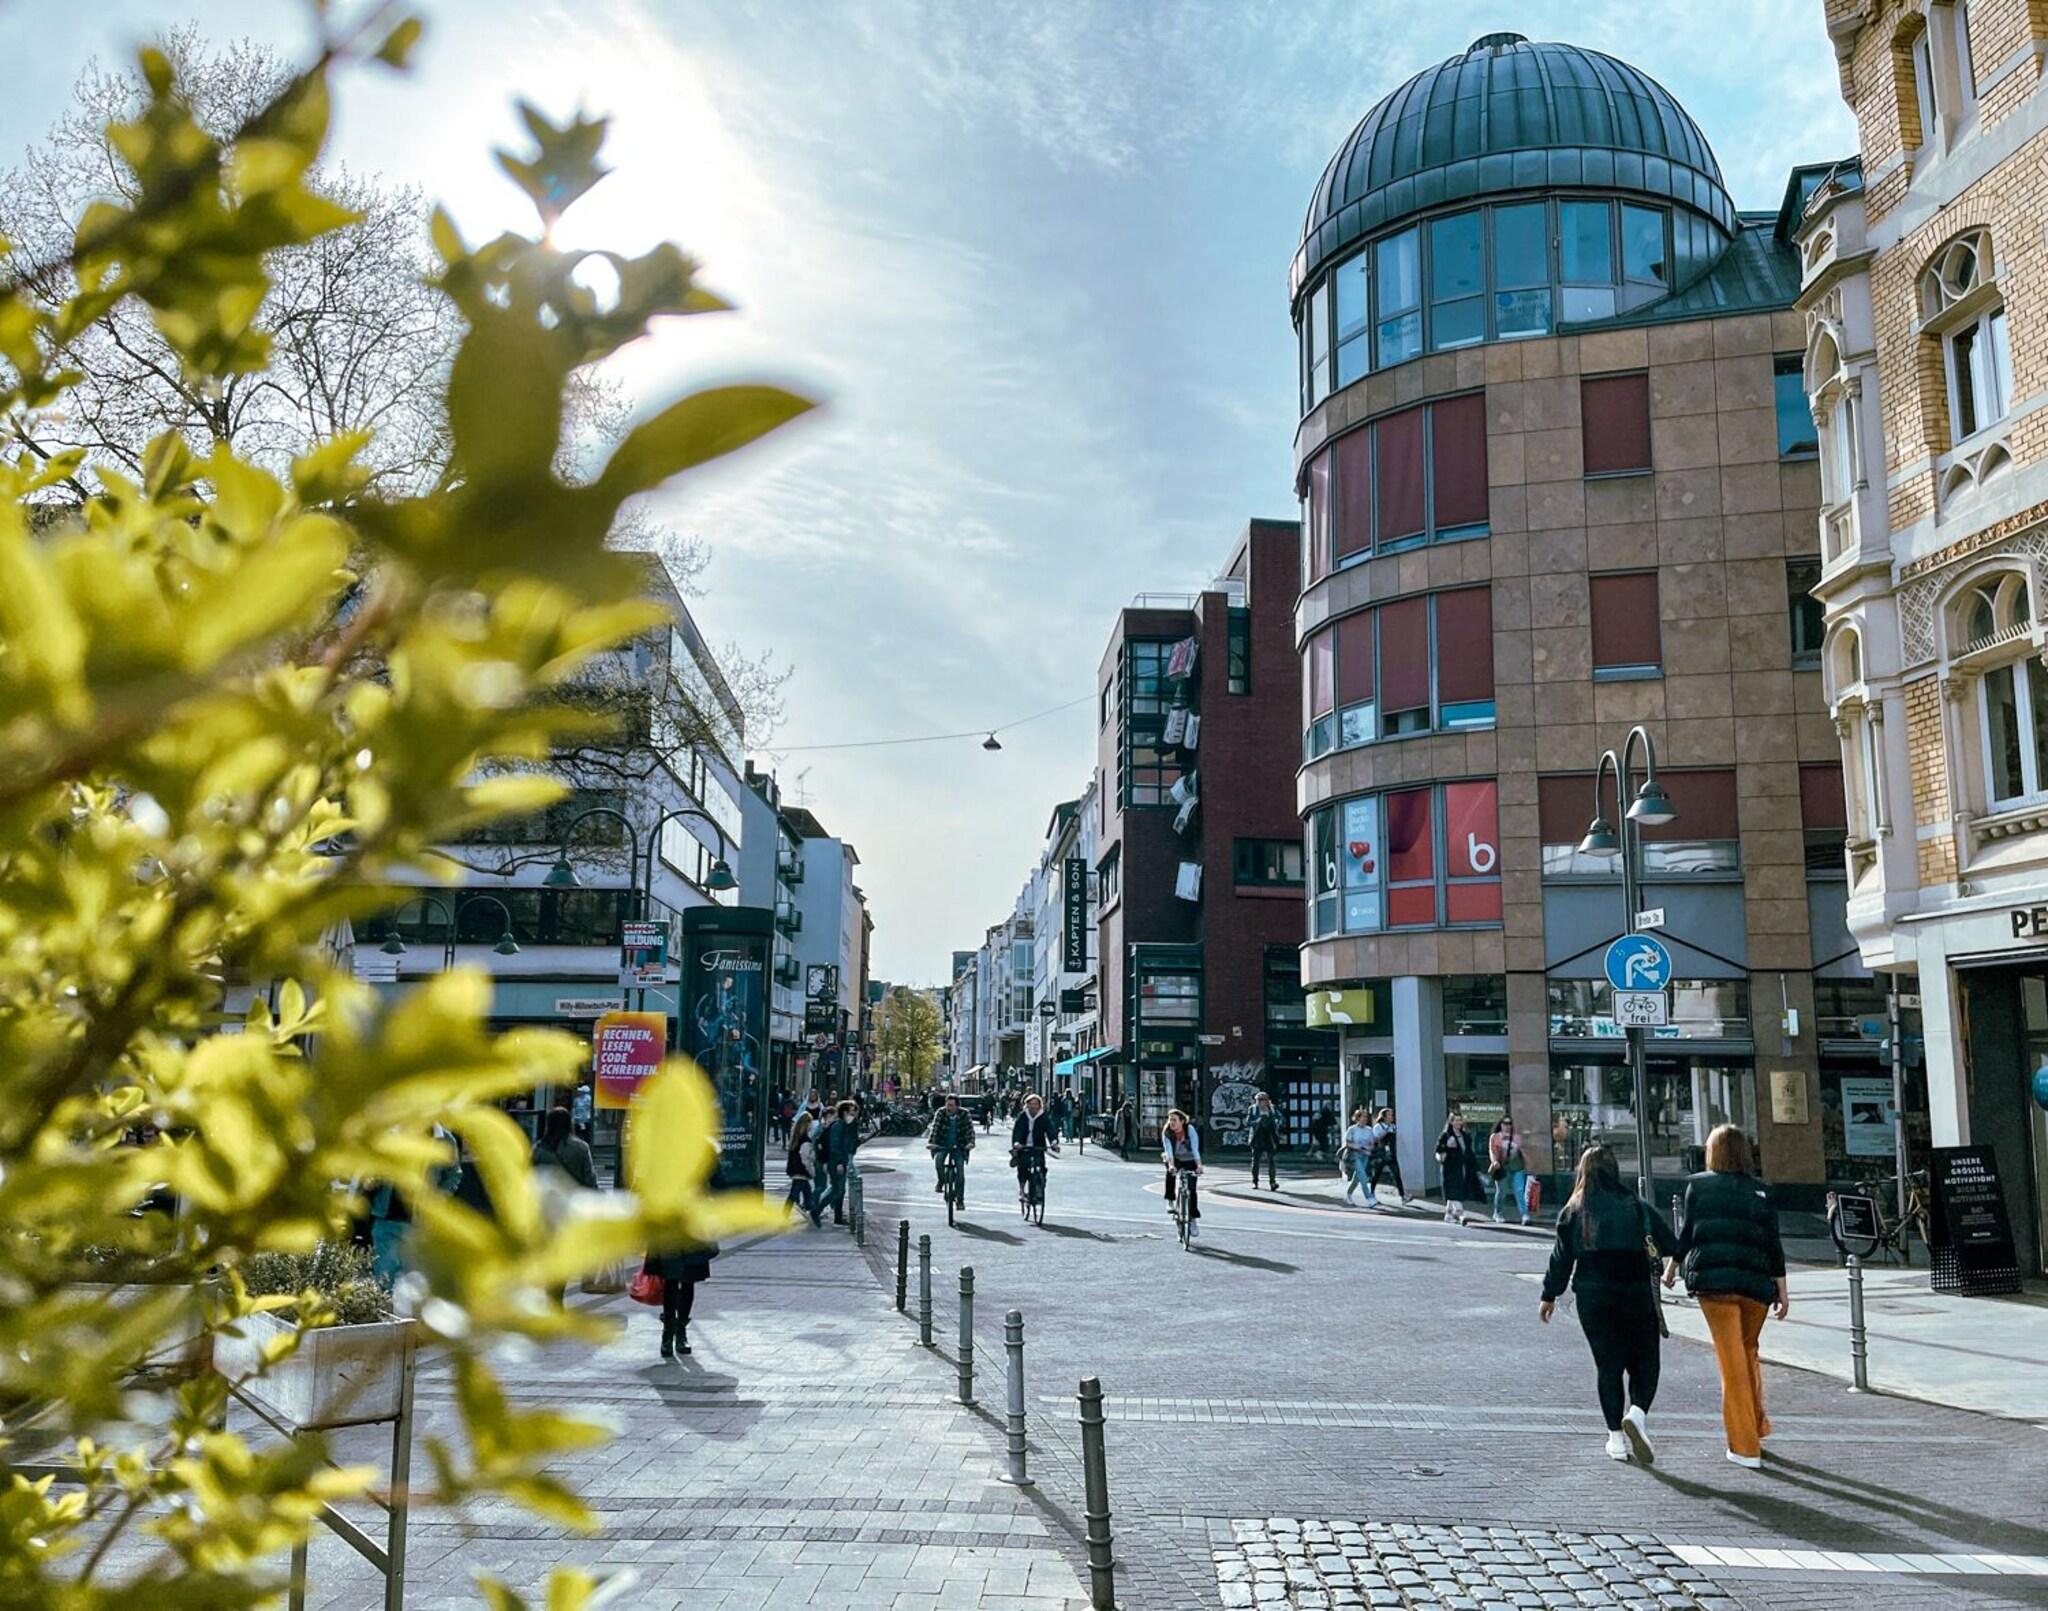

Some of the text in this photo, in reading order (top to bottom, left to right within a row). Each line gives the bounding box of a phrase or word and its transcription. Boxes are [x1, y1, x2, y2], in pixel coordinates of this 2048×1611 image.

[1468, 832, 1496, 873] b
[1071, 862, 1081, 957] KAPTEN & SON
[623, 934, 664, 946] BILDUNG
[1630, 1012, 1651, 1024] frei
[602, 1029, 654, 1043] RECHNEN,
[601, 1040, 636, 1054] LESEN,
[601, 1052, 629, 1063] CODE
[1950, 1157, 1981, 1167] UNSERE
